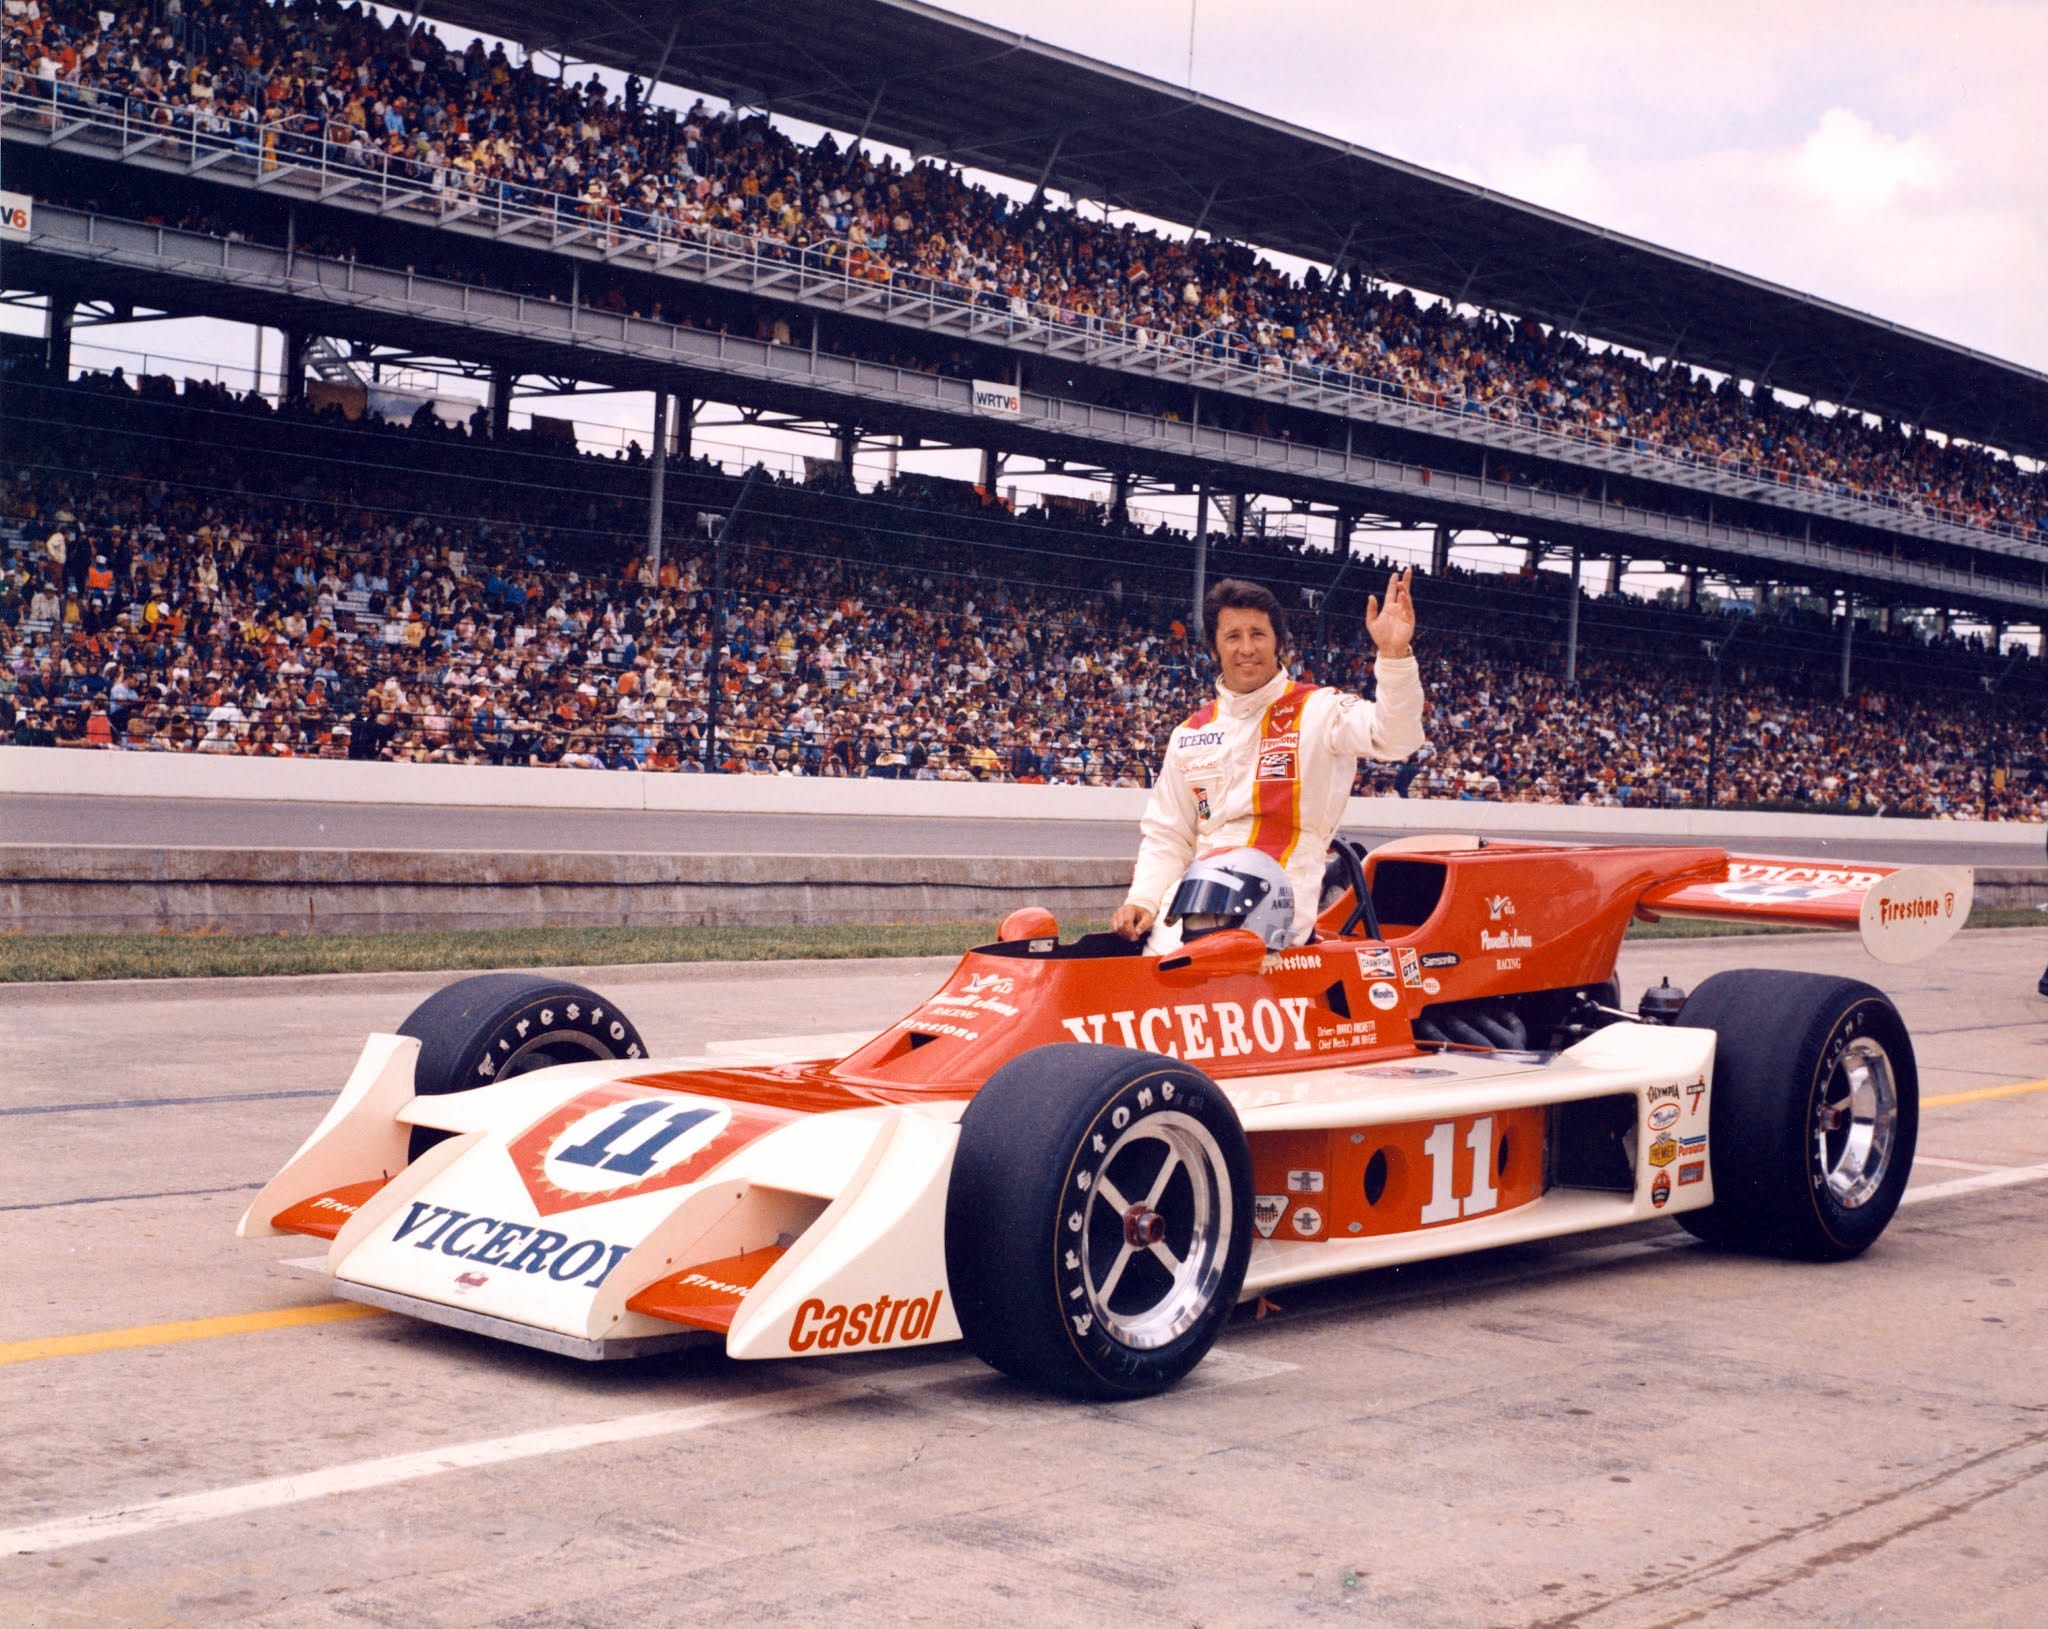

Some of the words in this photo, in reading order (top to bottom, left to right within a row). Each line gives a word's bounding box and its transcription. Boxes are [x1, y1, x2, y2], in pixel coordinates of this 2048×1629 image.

[1, 205, 28, 229] V6
[976, 391, 1018, 411] WRTV6
[1178, 732, 1225, 749] ICEROY
[1880, 898, 1939, 927] Firestone
[1268, 953, 1322, 975] restone
[1403, 961, 1417, 977] GTX
[1062, 997, 1311, 1060] VICEROY
[554, 1100, 721, 1177] 11
[1420, 1116, 1499, 1226] 11
[391, 1201, 633, 1289] VICEROY
[788, 1290, 943, 1353] Castrol
